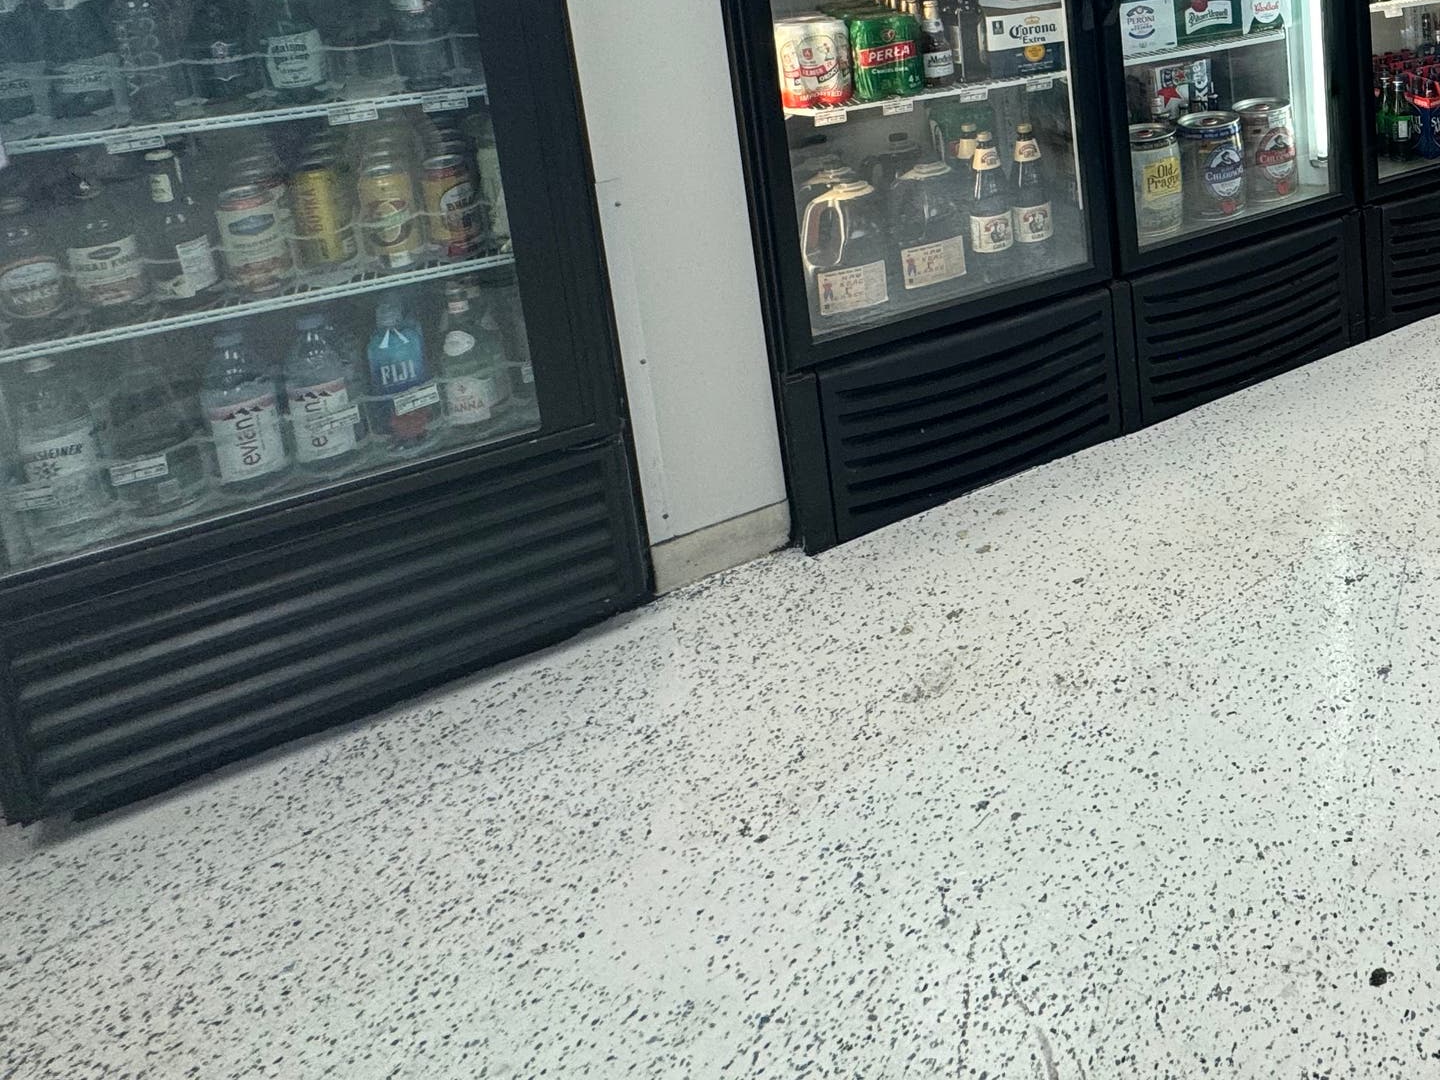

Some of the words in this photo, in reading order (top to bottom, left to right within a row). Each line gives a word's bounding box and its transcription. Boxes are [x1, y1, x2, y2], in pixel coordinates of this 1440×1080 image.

[1008, 23, 1058, 40] Corona
[1022, 35, 1047, 45] Extra
[868, 45, 911, 63] PERŁA
[380, 359, 417, 386] FIJI
[233, 413, 263, 468] evian
